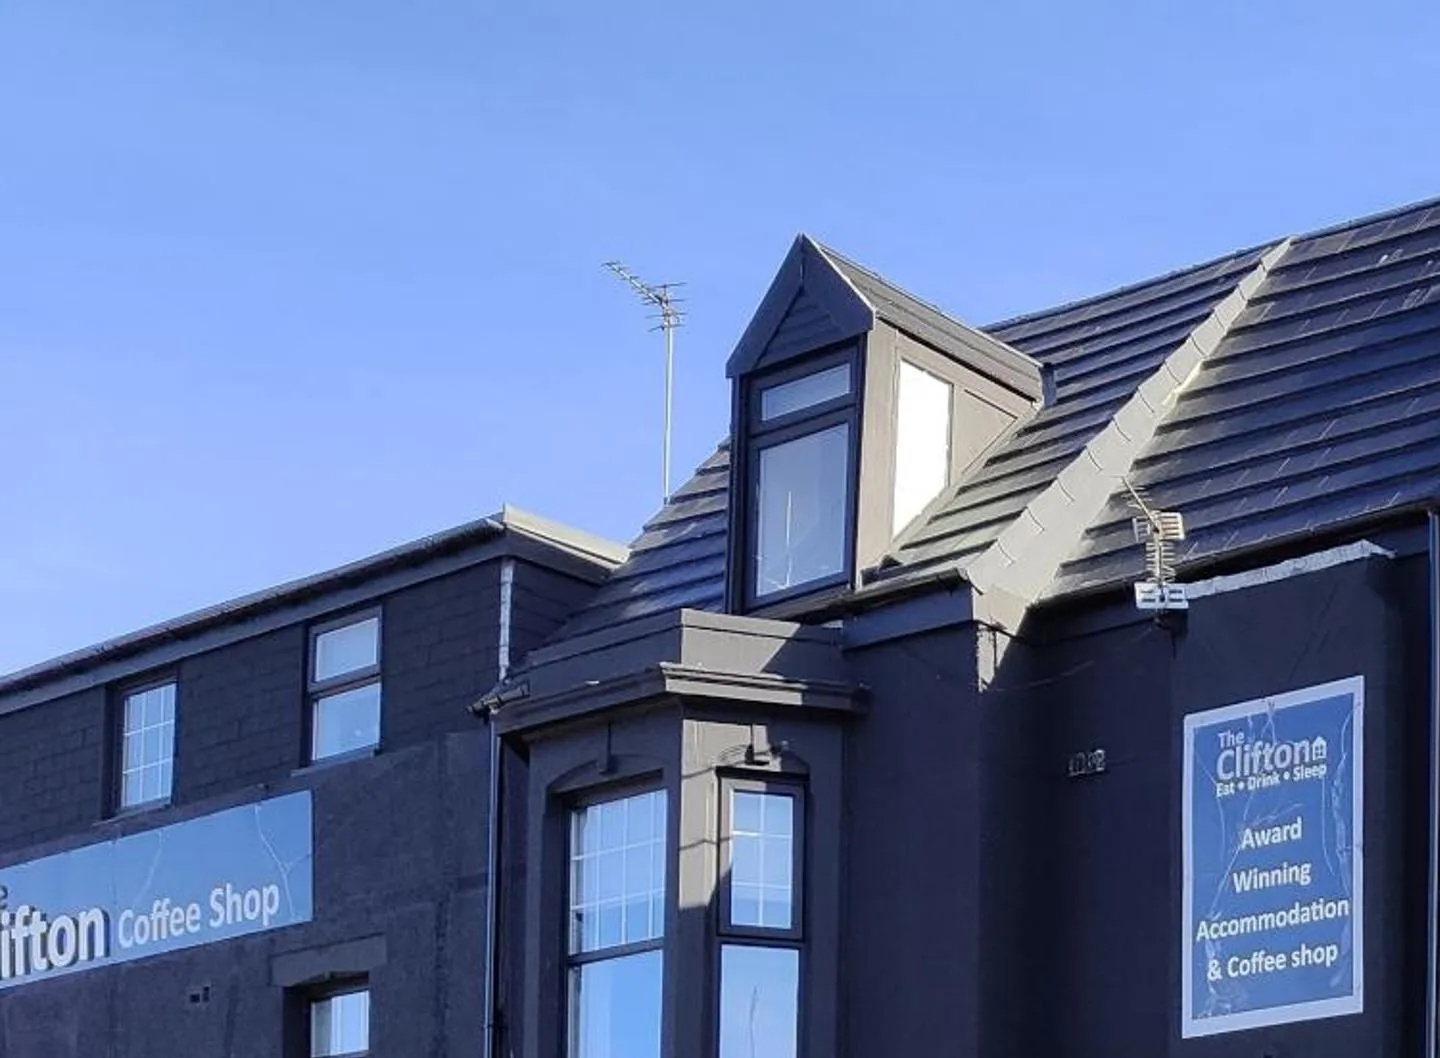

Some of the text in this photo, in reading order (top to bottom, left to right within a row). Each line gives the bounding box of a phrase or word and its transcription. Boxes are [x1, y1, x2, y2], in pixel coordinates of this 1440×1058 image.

[1218, 730, 1245, 749] The
[1217, 739, 1313, 780] Clifton
[1216, 764, 1327, 798] Eat Drink Sleep
[1240, 817, 1302, 850] Award
[1232, 863, 1312, 894] Winning
[1, 882, 280, 978] ifton Coffee Shop
[1196, 898, 1350, 942] Accommodation
[1207, 942, 1339, 982] & Coffee shop
